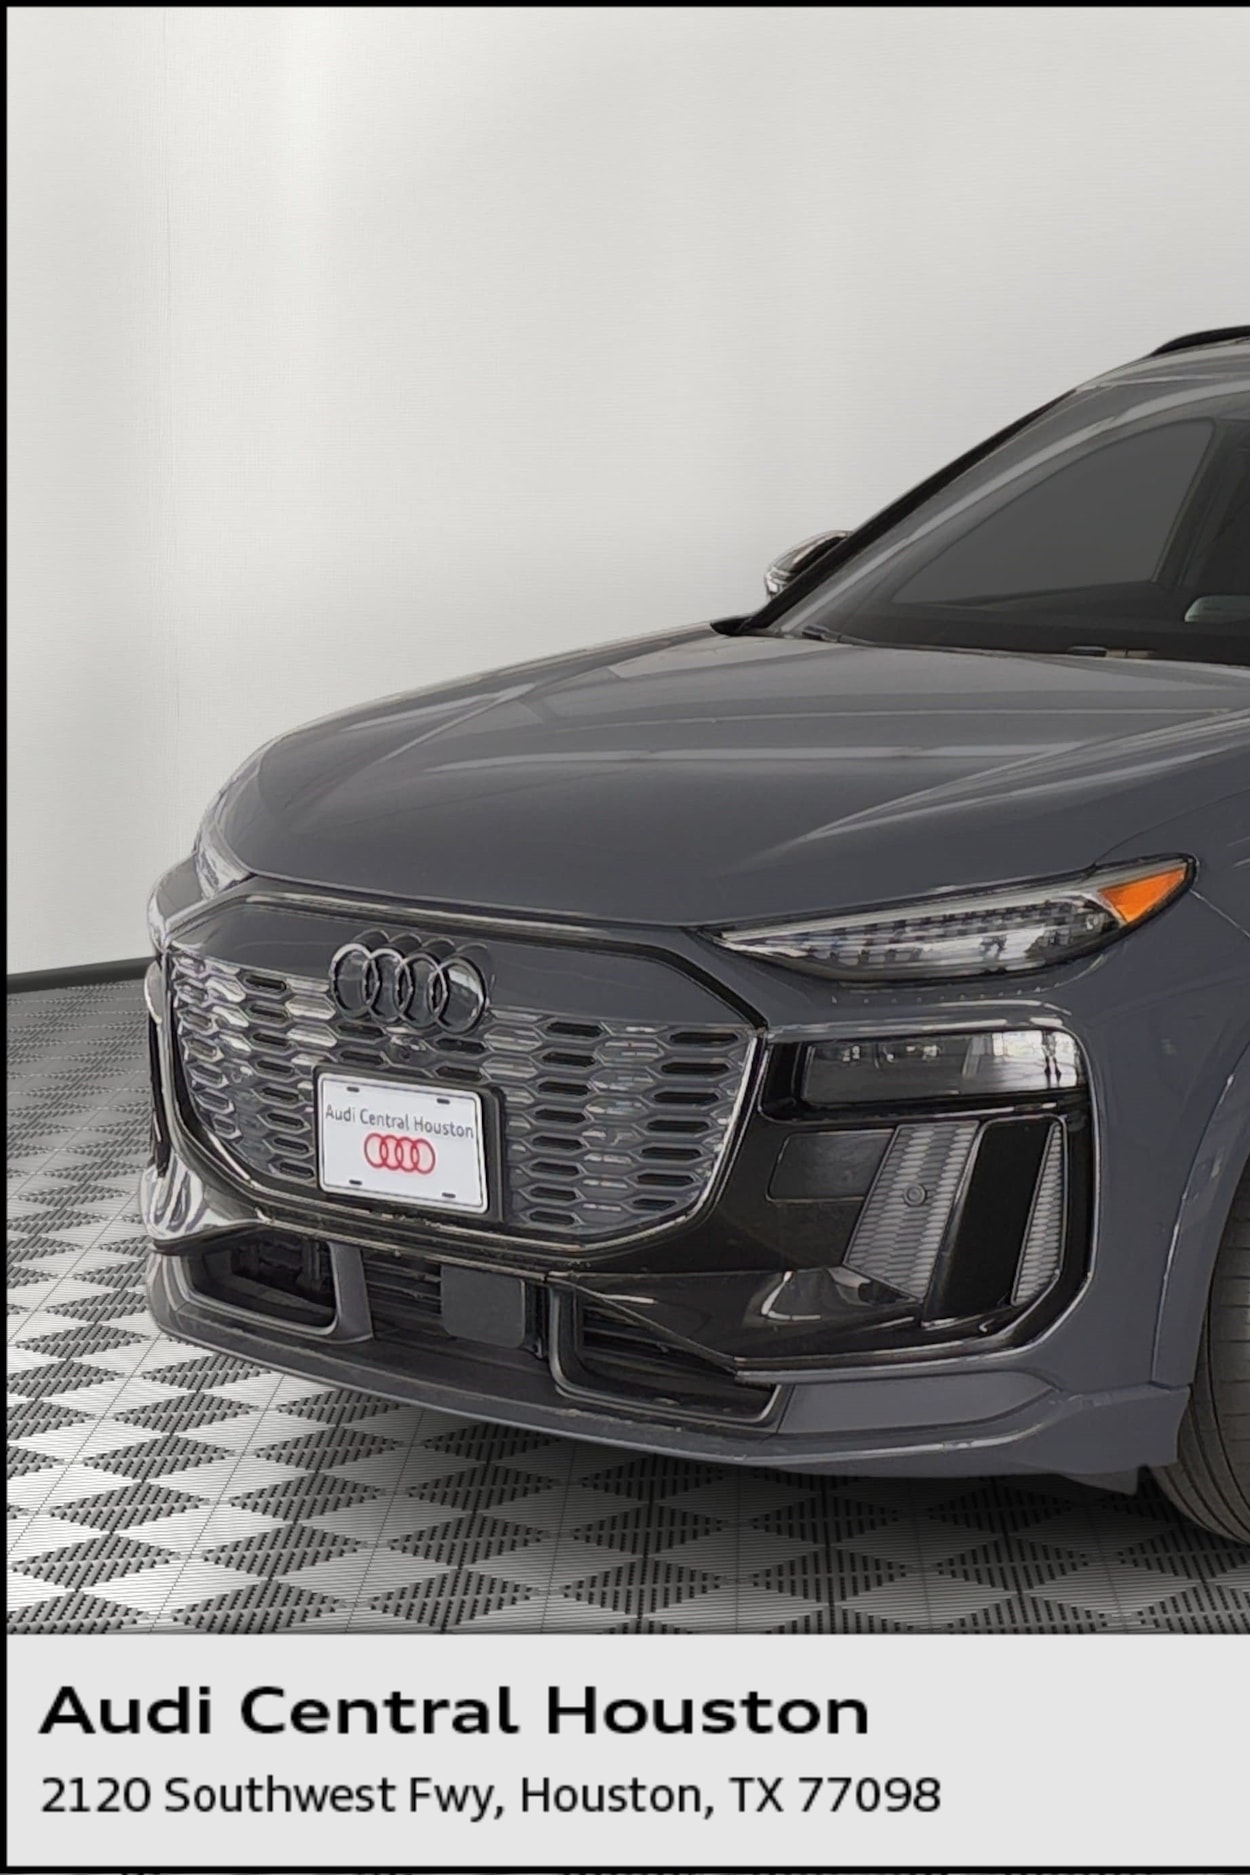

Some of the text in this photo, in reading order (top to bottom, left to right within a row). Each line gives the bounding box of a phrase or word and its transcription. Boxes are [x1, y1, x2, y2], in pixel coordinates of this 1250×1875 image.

[326, 1104, 475, 1139] Audi Central Houston
